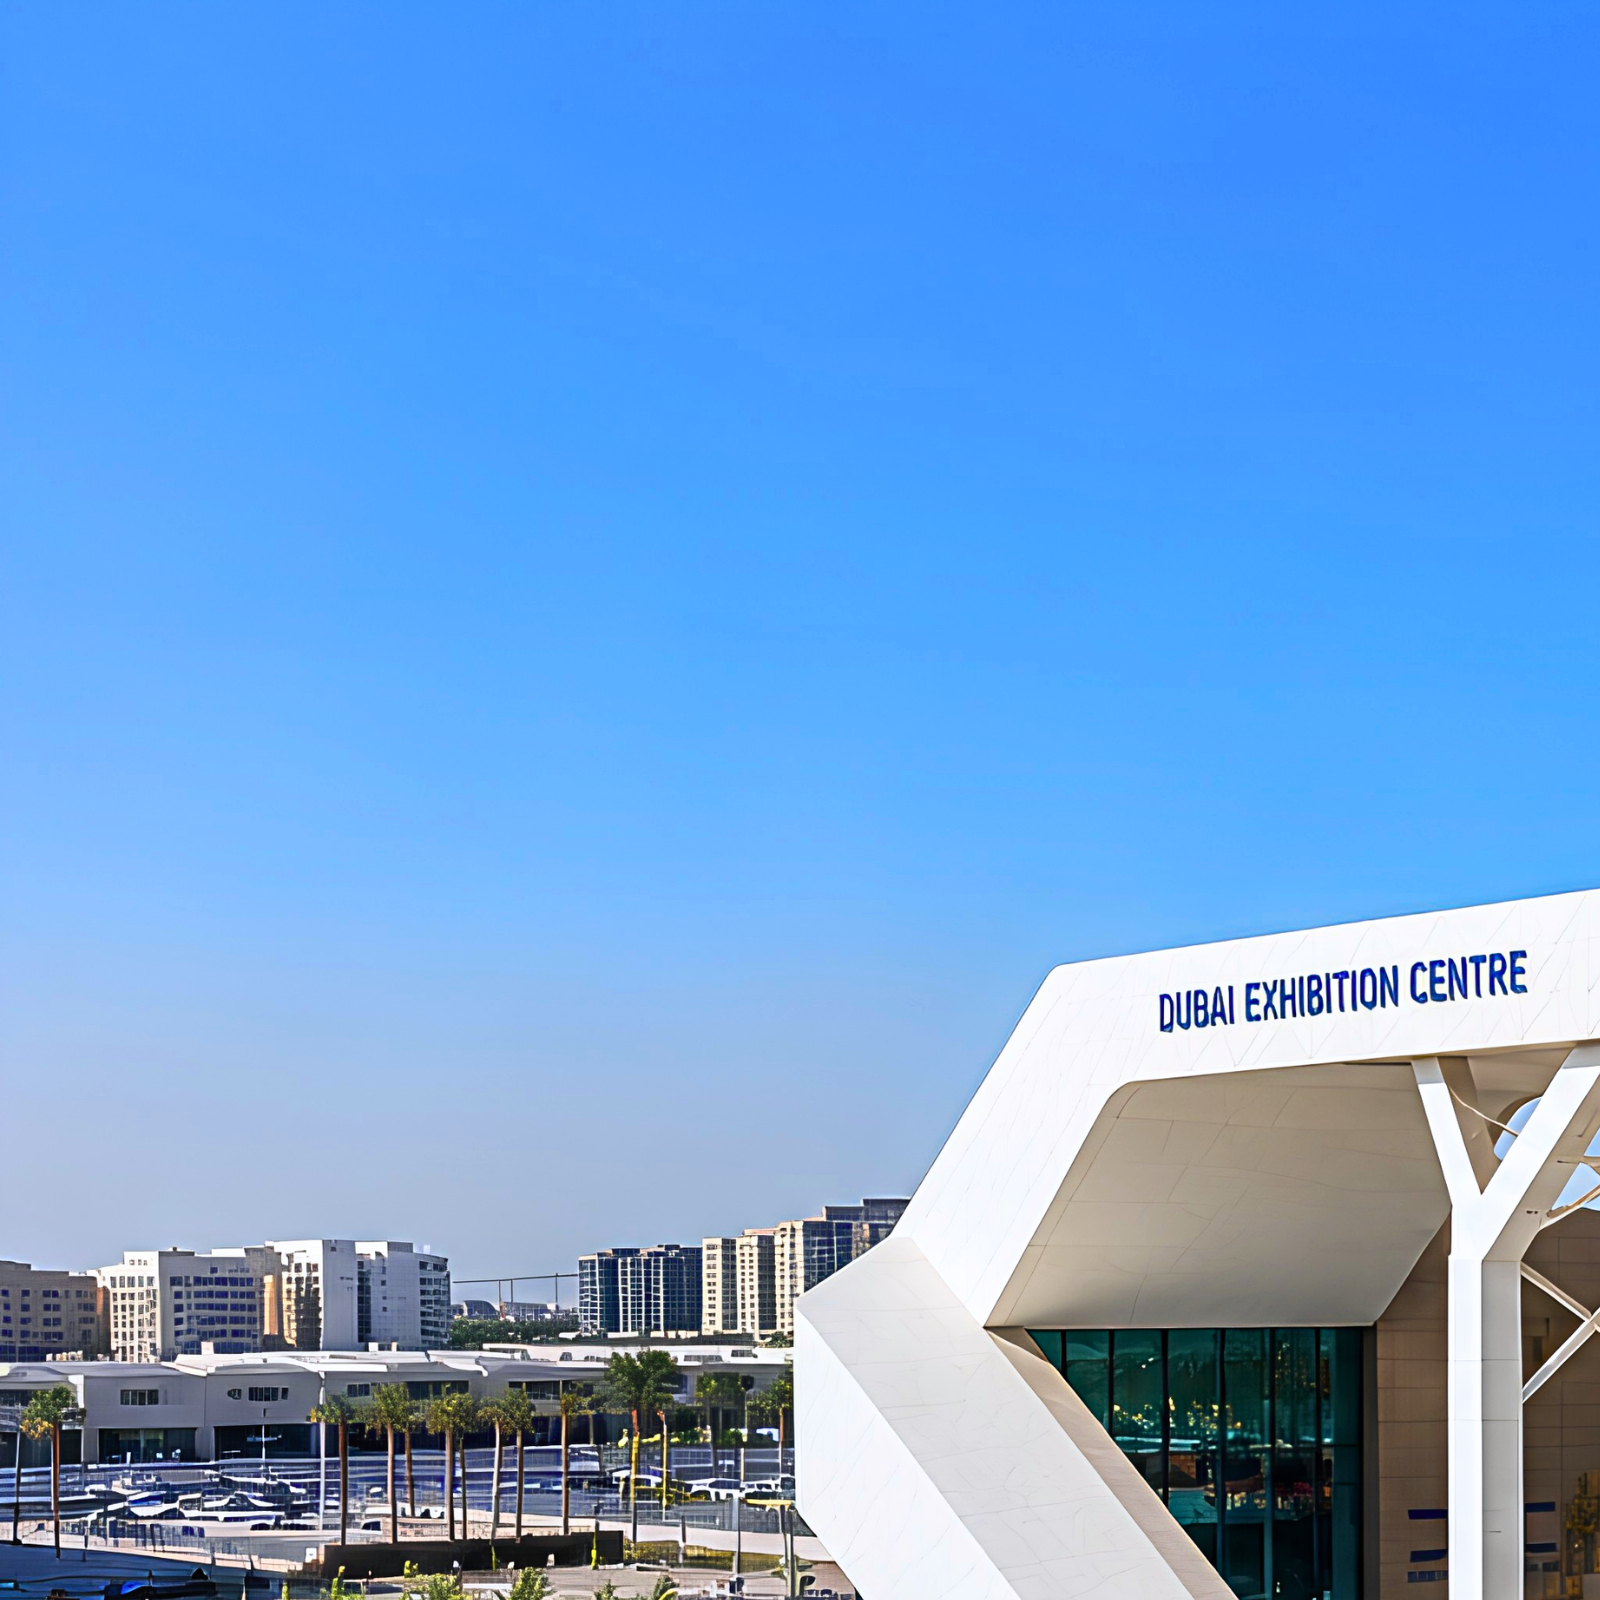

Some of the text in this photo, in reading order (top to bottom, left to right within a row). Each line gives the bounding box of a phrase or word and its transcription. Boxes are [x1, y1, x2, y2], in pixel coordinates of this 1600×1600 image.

[1159, 949, 1528, 1033] DUBAI EXHIBITION CENTRE
